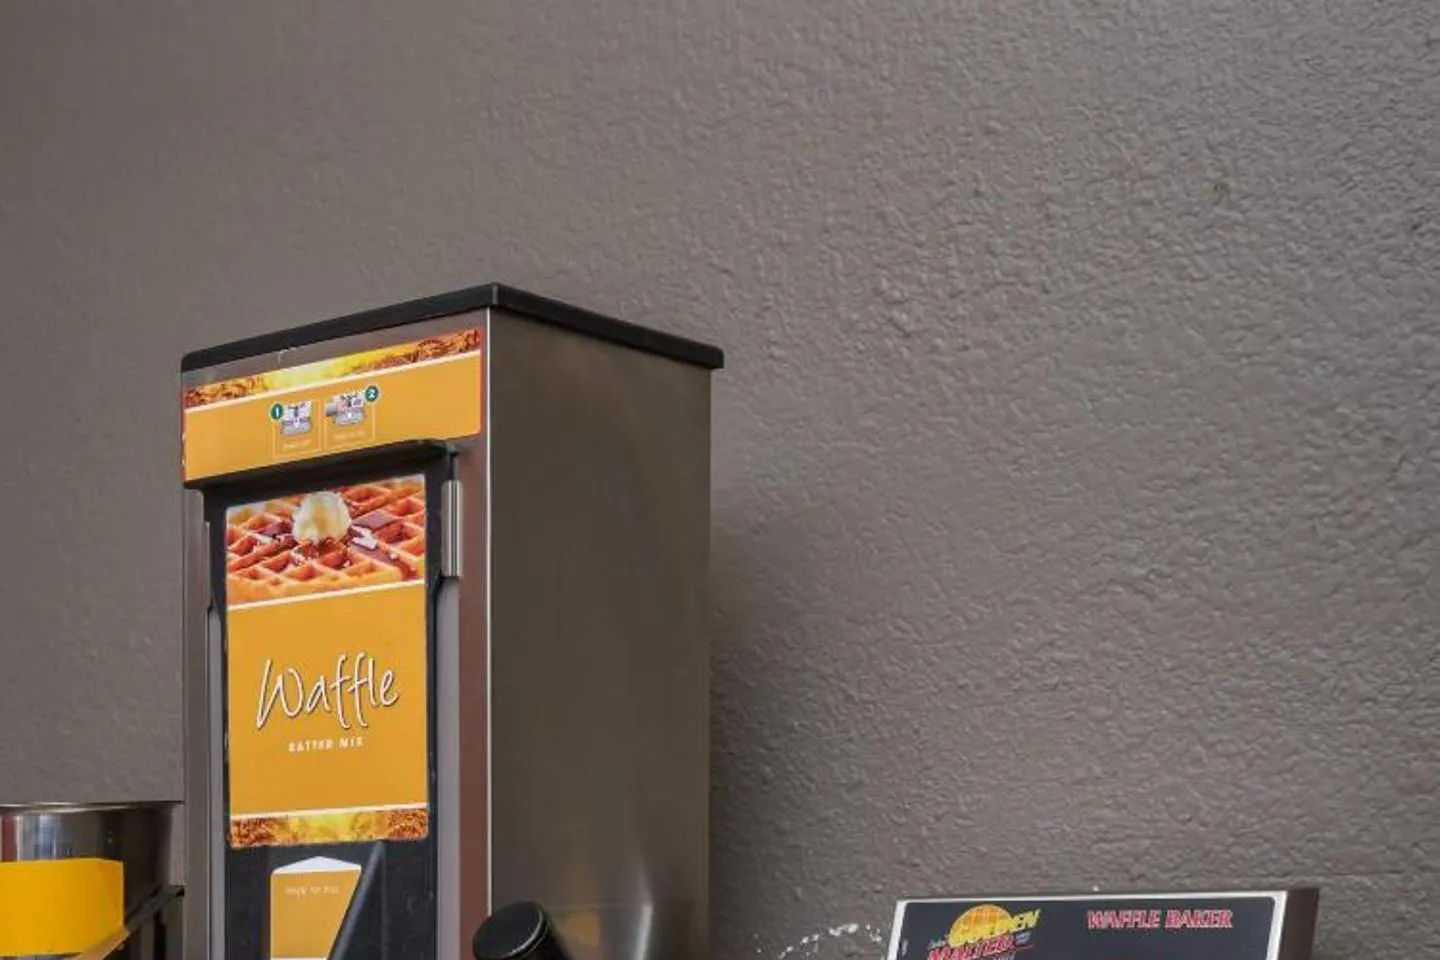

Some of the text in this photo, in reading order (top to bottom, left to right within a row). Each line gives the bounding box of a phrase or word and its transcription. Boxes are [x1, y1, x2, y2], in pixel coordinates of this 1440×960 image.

[255, 651, 401, 730] Waffle
[947, 909, 1042, 948] GOLDEN
[1086, 909, 1234, 929] WAFFLE BAKER
